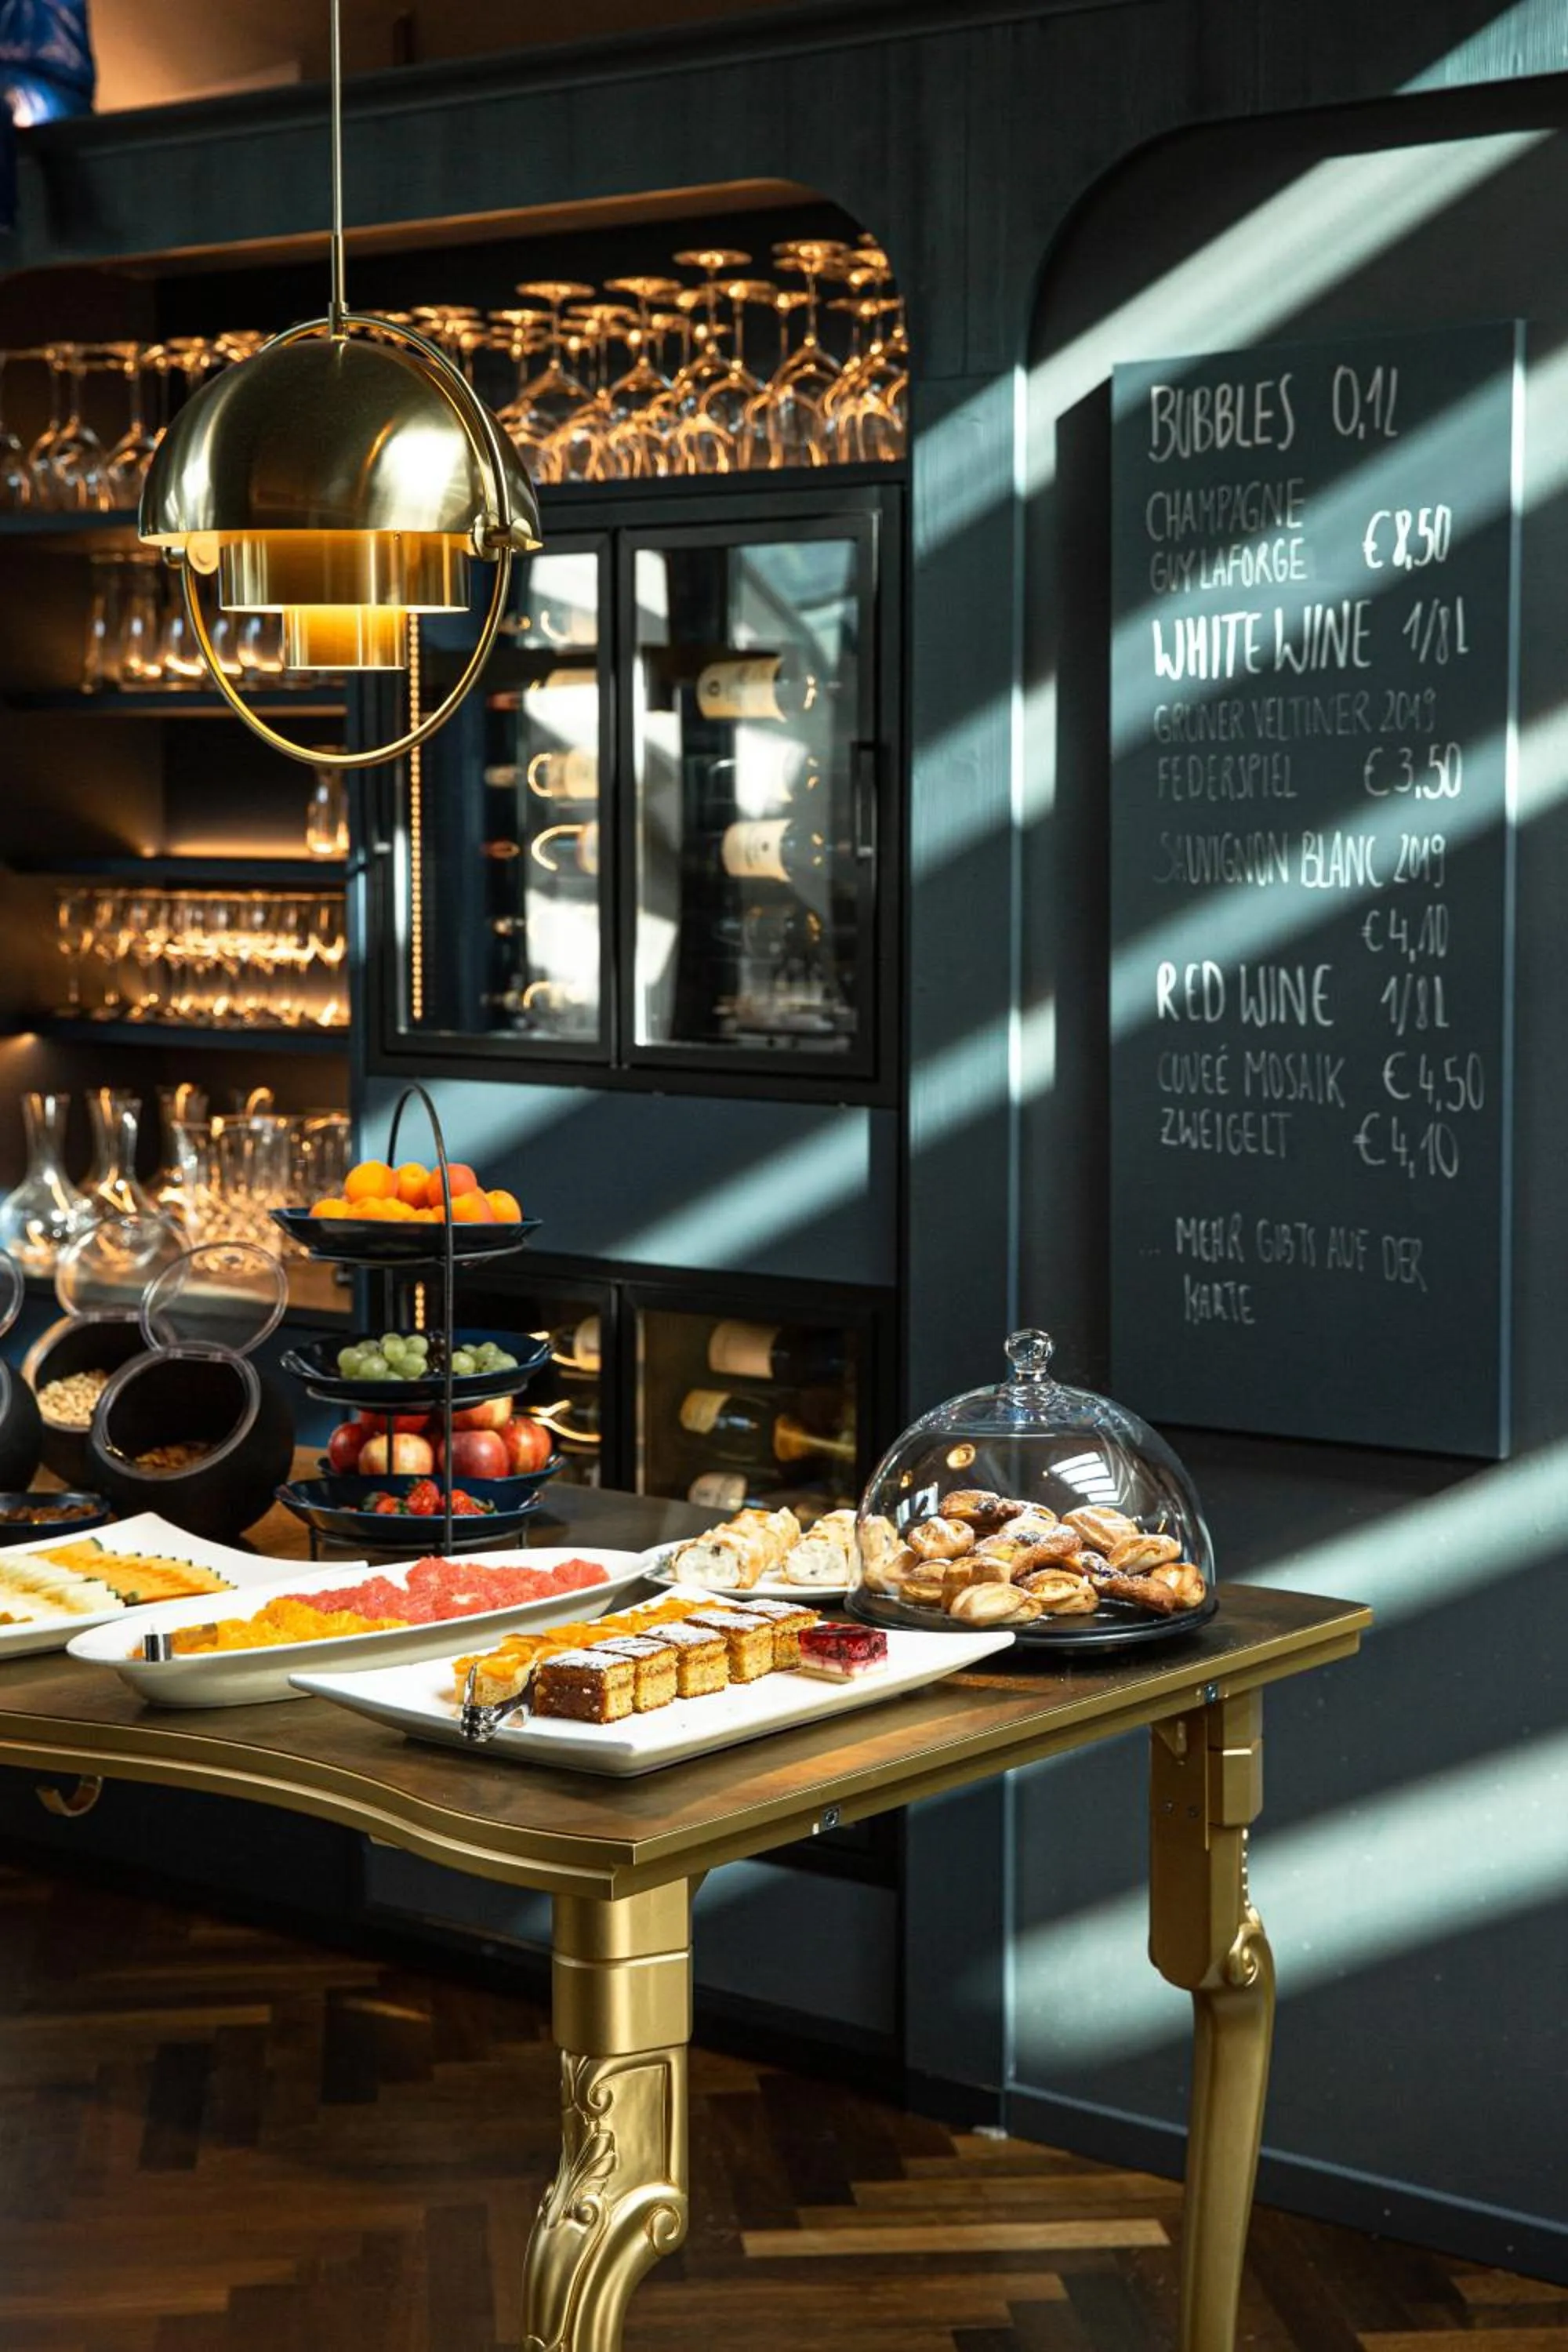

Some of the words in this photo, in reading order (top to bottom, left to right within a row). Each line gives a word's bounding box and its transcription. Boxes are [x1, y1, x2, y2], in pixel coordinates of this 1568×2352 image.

[1149, 373, 1294, 463] BUBBLES
[1334, 365, 1399, 440] 0,1L
[1145, 477, 1305, 541] CHAMPAGNE
[1149, 550, 1192, 593] GUY
[1200, 538, 1308, 590] LAFORGE
[1152, 611, 1262, 681] WHITE
[1274, 599, 1372, 675] WINE
[1379, 687, 1437, 734] 2019
[1157, 752, 1298, 802] FEDERSPIEL
[1300, 831, 1384, 888] BLANC
[1393, 833, 1446, 888] 2019
[1156, 960, 1225, 1023] RED
[1240, 964, 1335, 1028] WINE
[1244, 1050, 1346, 1109] MOSAIK
[1160, 1107, 1294, 1160] ZWEIGELT
[1175, 1211, 1245, 1264] MEHR
[1327, 1226, 1370, 1272] AUF
[1381, 1235, 1428, 1294] DER
[1183, 1272, 1256, 1326] KARTE
